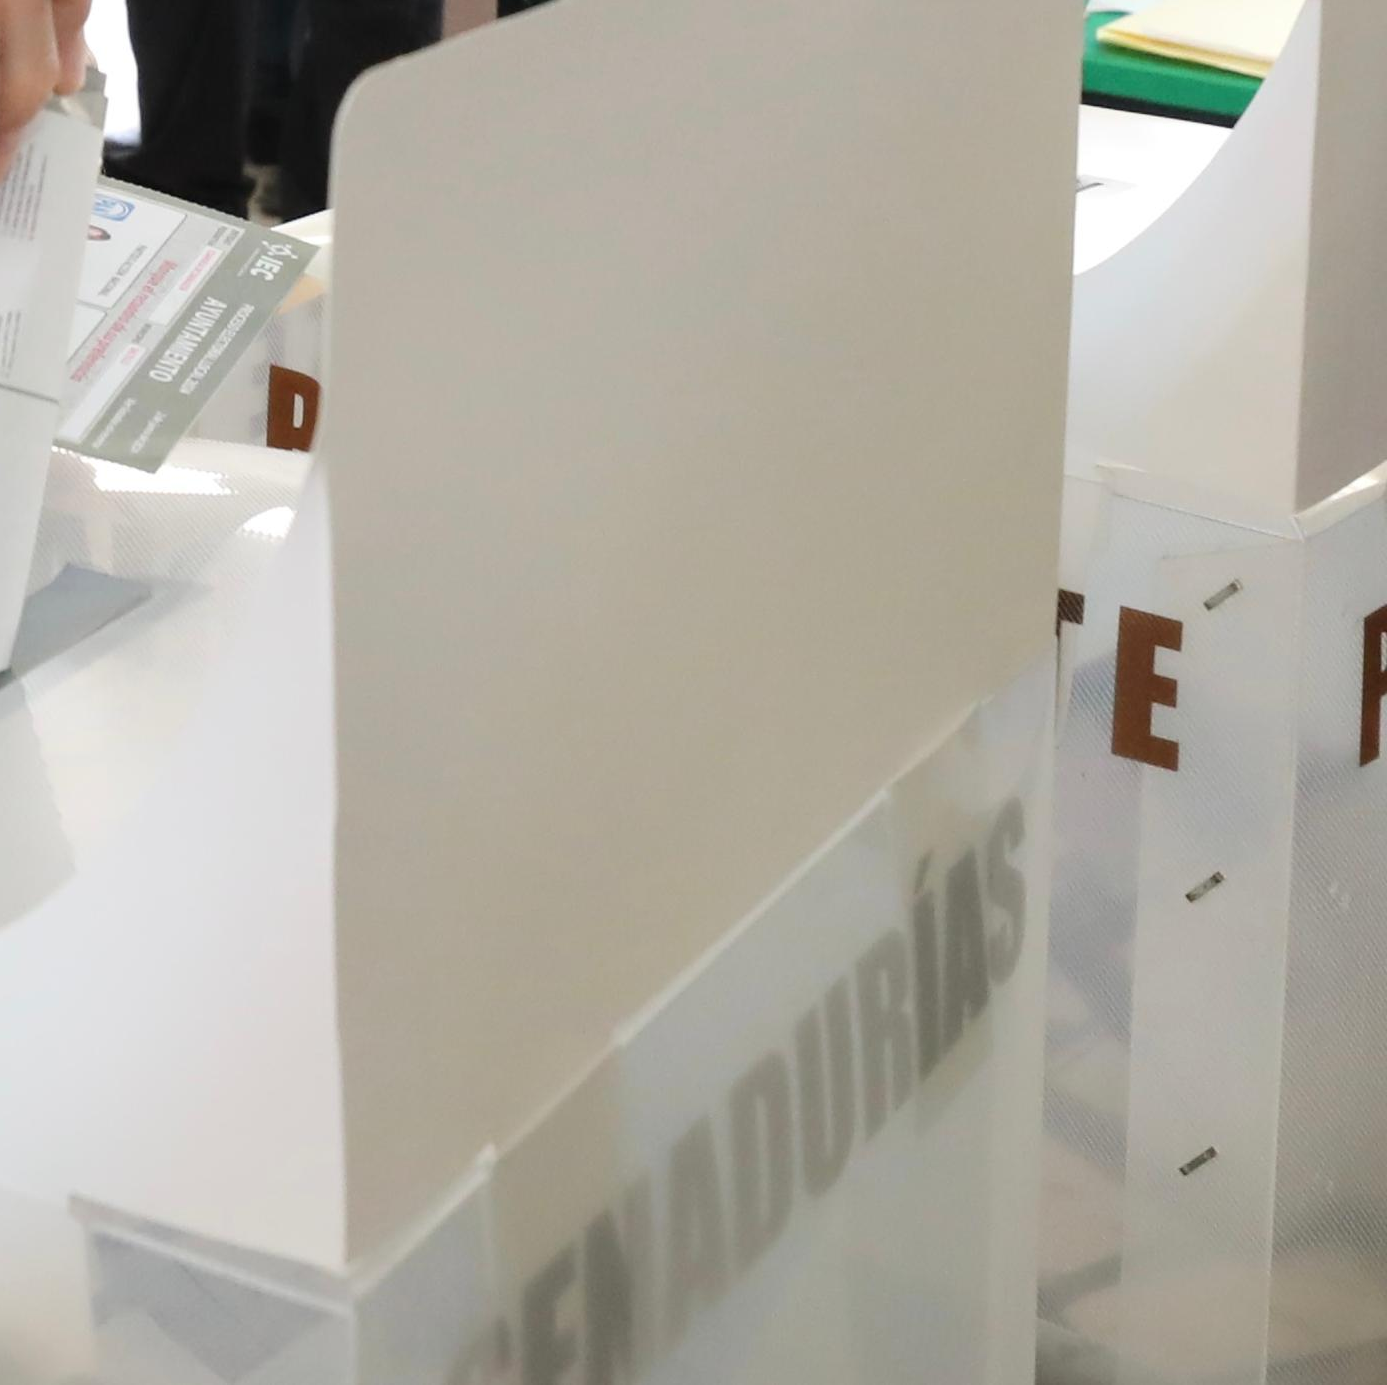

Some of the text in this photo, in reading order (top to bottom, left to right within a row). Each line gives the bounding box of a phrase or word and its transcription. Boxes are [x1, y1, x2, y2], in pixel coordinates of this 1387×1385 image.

[251, 254, 285, 281] IEC
[149, 296, 227, 383] AYUNTAMIENTO
[449, 796, 1026, 1385] ENADURÍAS
